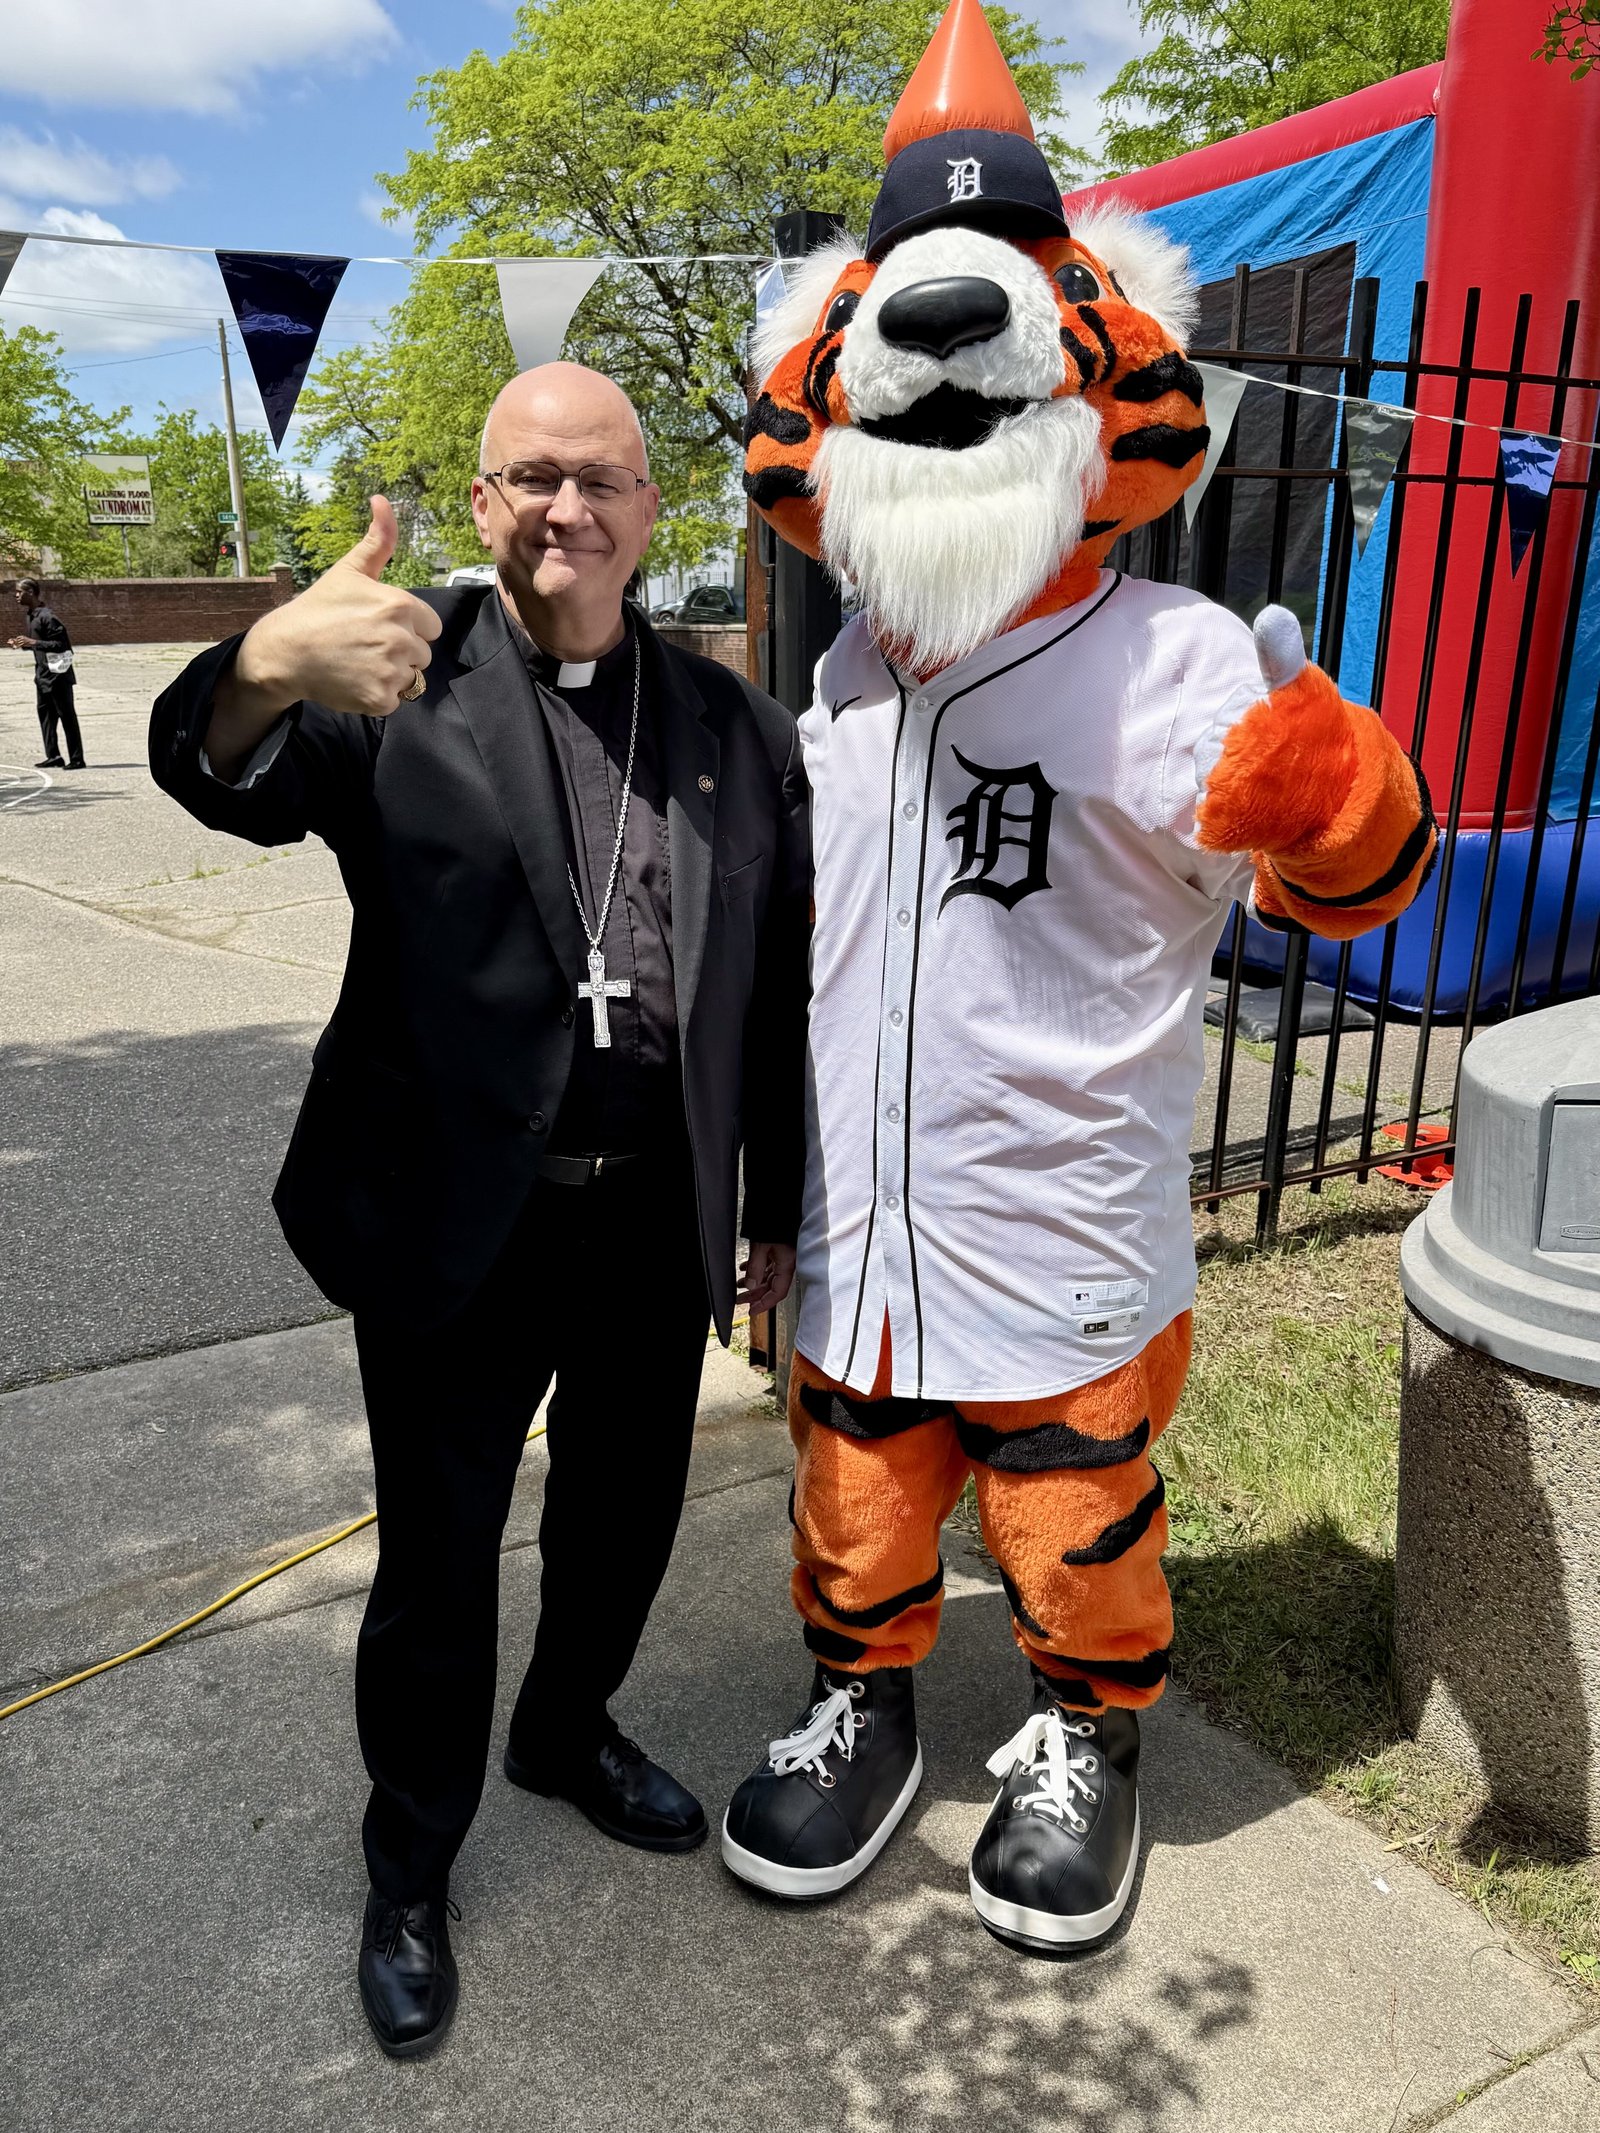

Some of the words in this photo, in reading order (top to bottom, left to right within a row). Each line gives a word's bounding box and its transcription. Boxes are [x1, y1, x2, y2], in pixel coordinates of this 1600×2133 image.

[946, 156, 984, 204] D
[97, 500, 151, 515] UNDROMAT
[128, 490, 150, 498] FLOOD
[937, 743, 1060, 921] D
